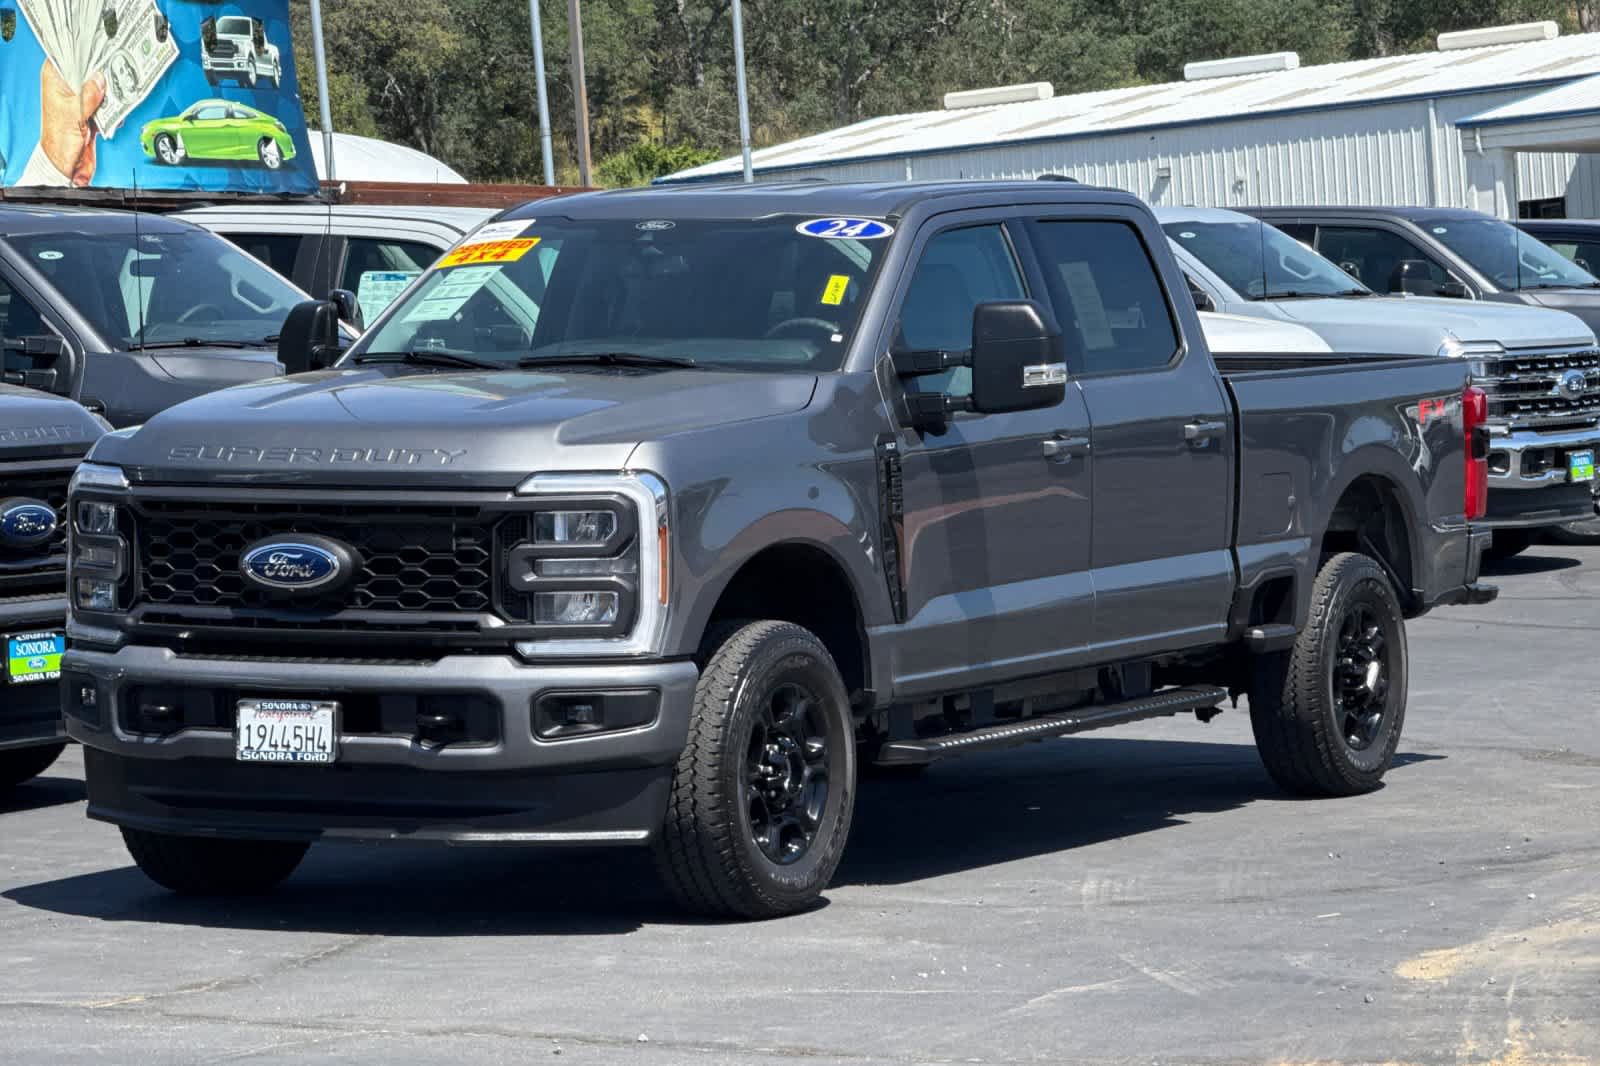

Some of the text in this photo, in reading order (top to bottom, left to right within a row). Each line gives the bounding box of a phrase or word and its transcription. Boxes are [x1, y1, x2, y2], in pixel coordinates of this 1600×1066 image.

[817, 219, 869, 237] 24
[1418, 398, 1458, 425] FX
[167, 447, 467, 464] SUPER DUTY
[264, 552, 316, 577] Ford
[15, 640, 56, 657] SONORA
[262, 702, 297, 710] SONORA
[244, 724, 327, 752] 19445H4
[242, 752, 328, 761] SONORA FORD
